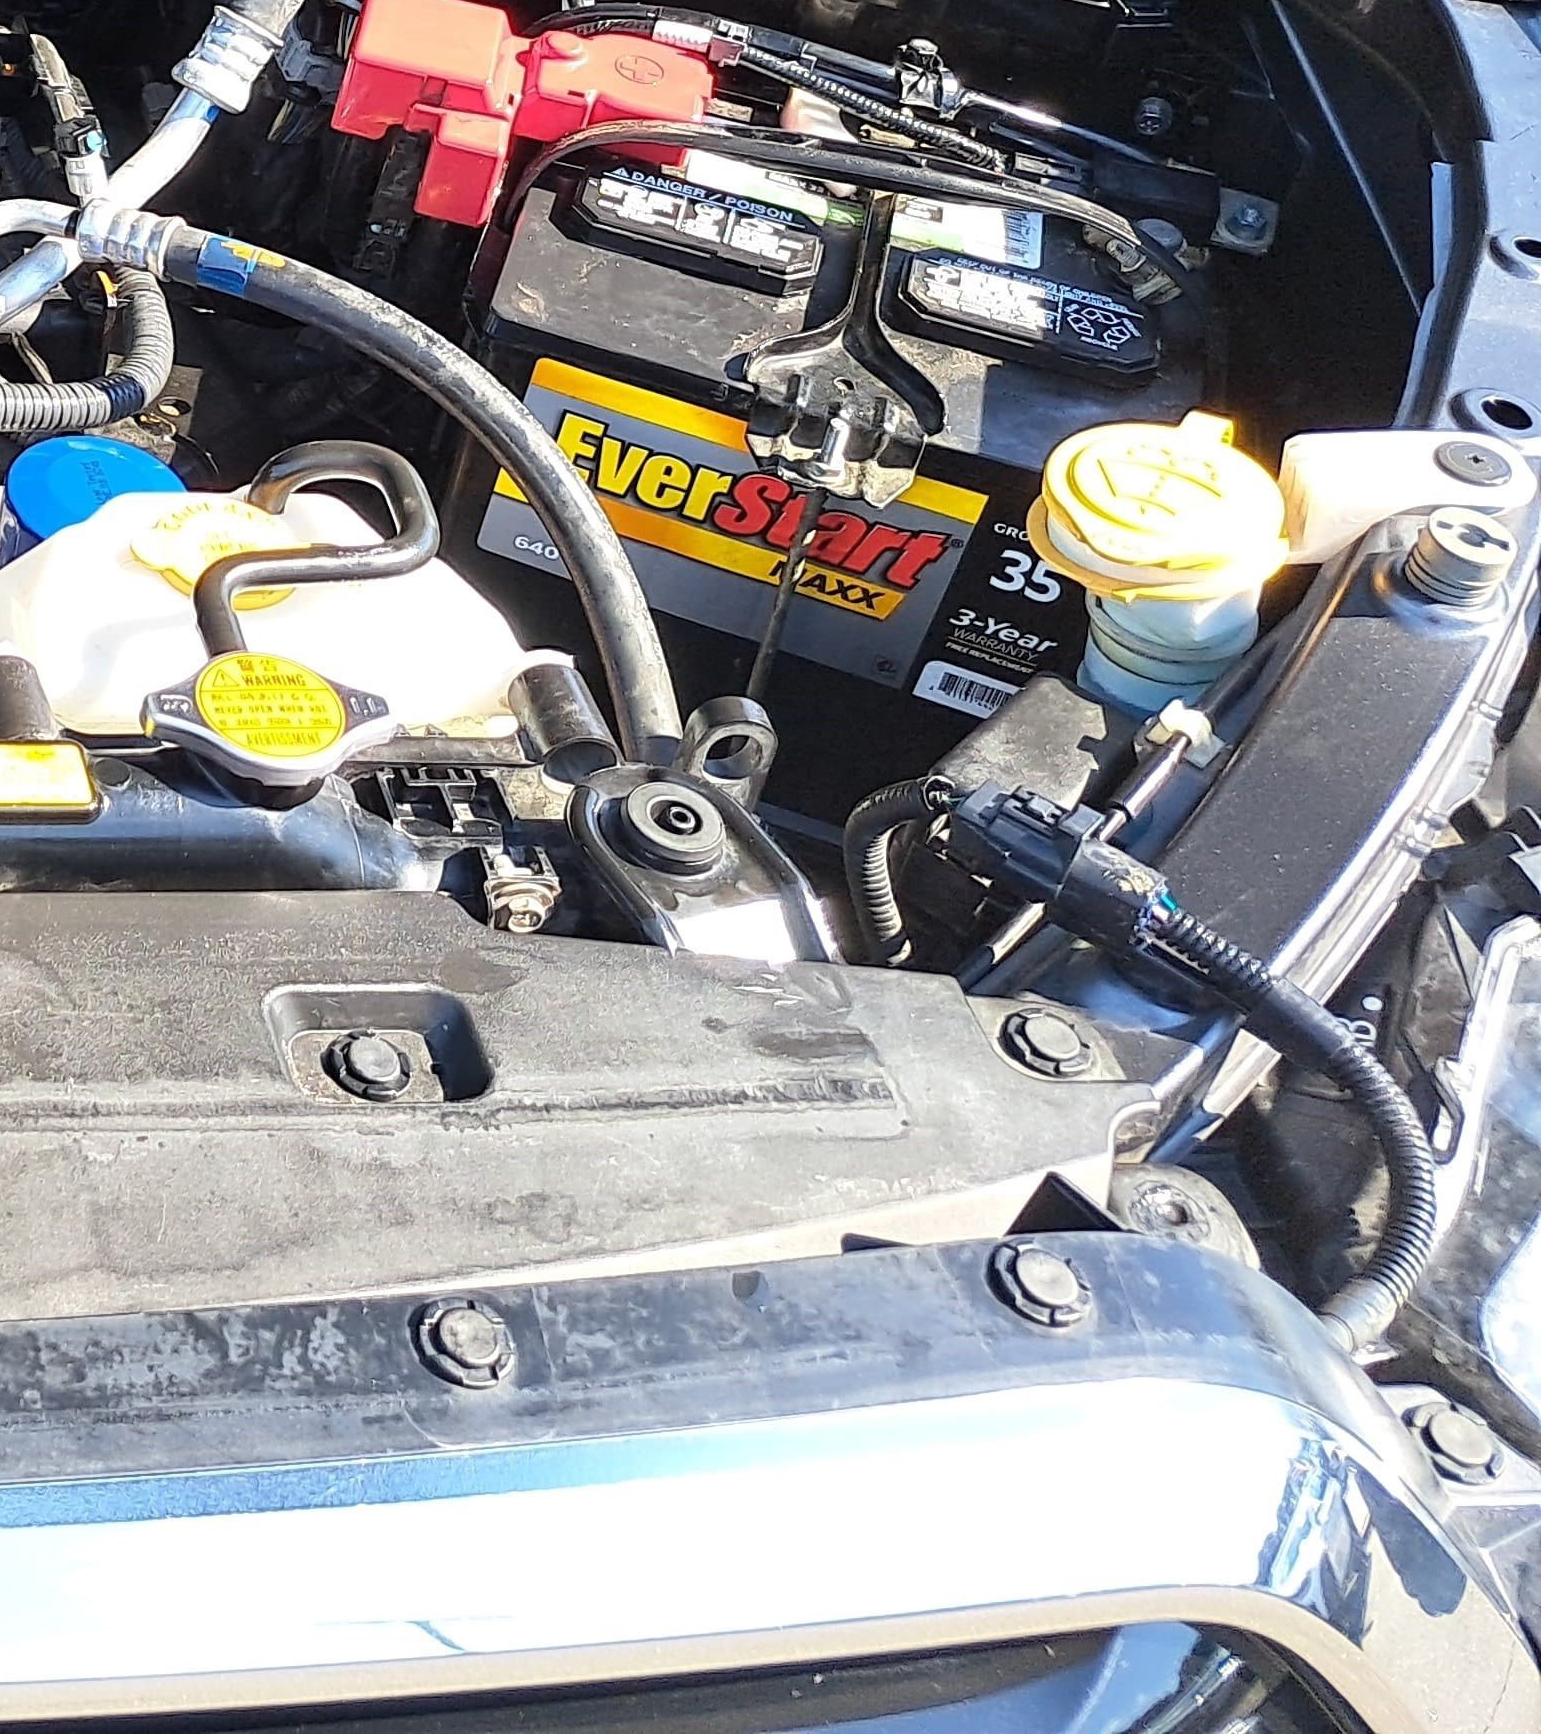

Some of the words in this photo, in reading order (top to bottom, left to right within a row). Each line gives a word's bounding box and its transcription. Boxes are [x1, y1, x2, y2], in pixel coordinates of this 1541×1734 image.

[631, 170, 707, 200] DANGER
[724, 195, 794, 222] POISON
[554, 411, 953, 589] EverStart
[513, 535, 559, 560] 640
[993, 522, 1030, 542] GRO
[989, 548, 1061, 604] 35
[948, 608, 1060, 654] 3-Year
[953, 627, 1039, 662] WARRANTY
[242, 673, 307, 688] WARNING
